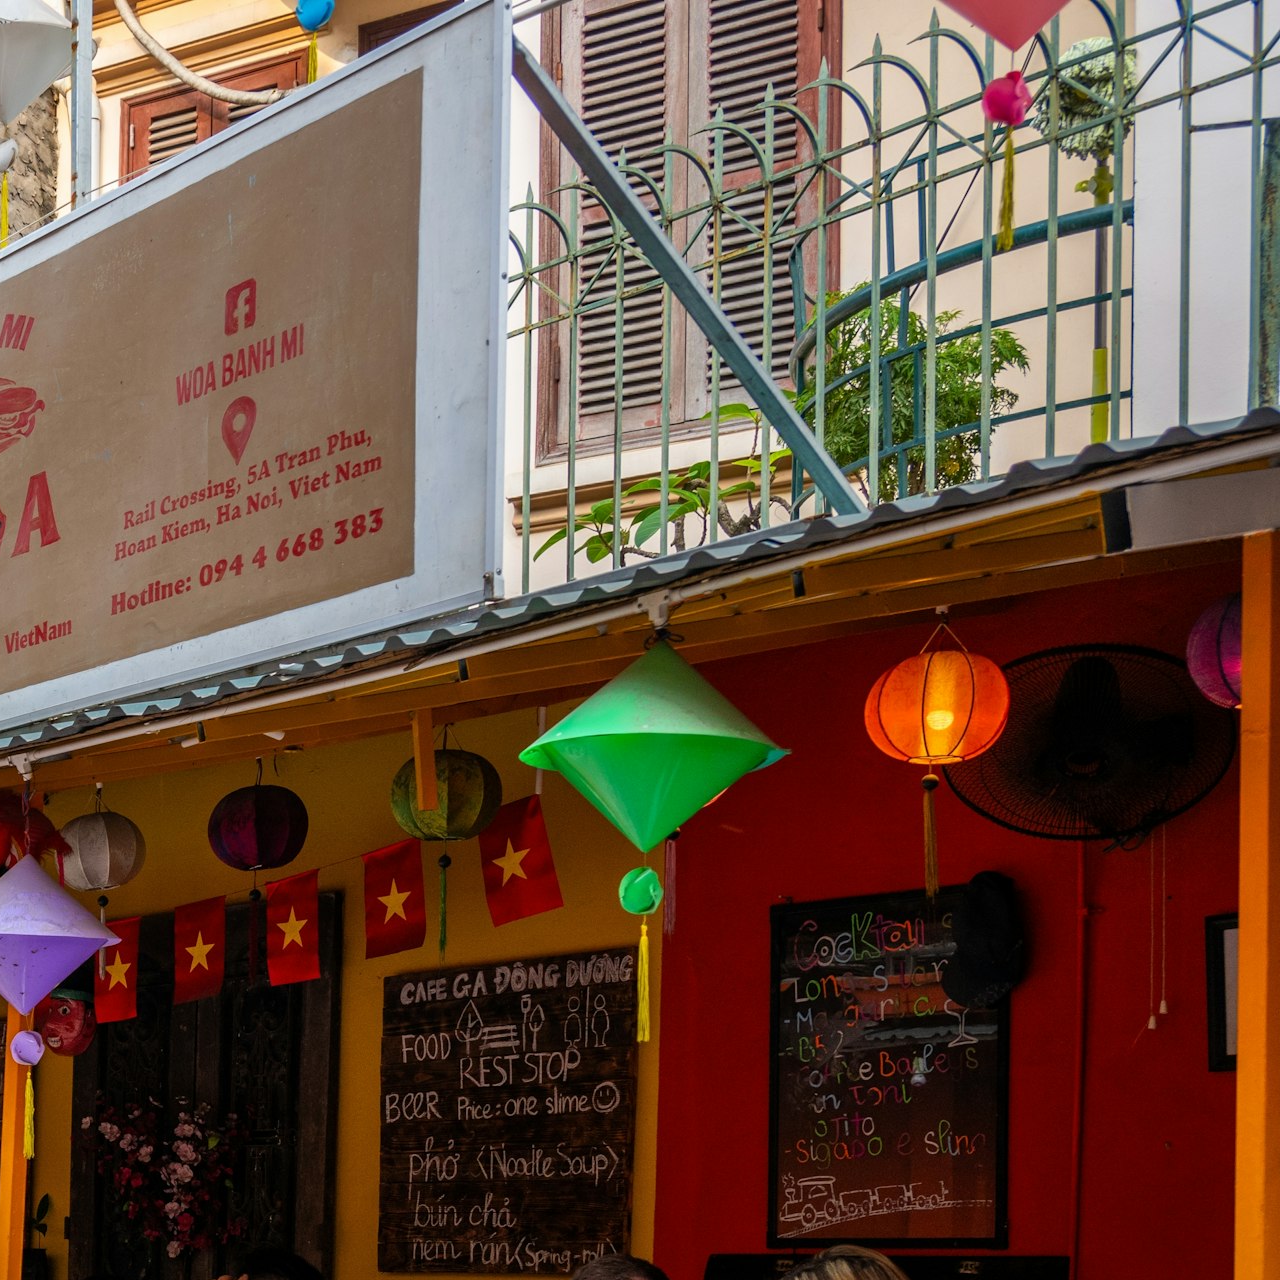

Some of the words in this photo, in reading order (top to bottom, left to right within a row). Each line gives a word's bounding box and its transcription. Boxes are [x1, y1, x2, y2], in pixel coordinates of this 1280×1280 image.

[175, 360, 217, 406] WOA
[221, 335, 275, 388] BANH
[280, 322, 305, 363] MI
[123, 500, 156, 530] Rail
[160, 476, 241, 515] Crossing,
[247, 460, 271, 485] 5A
[275, 446, 321, 474] Tran
[326, 429, 372, 457] Phu,
[114, 533, 157, 561] Hoan
[161, 516, 211, 545] Kiem,
[216, 504, 241, 526] Ha
[246, 487, 283, 515] Noi,
[288, 473, 330, 500] Viet
[335, 455, 382, 485] Nam
[110, 576, 192, 616] Hotline:
[199, 554, 244, 587] 094
[251, 546, 268, 570] 4
[275, 528, 324, 562] 668
[334, 507, 384, 545] 383
[4, 619, 72, 654] VietNam
[400, 977, 448, 1005] CAFE
[452, 970, 488, 999] GA
[401, 1033, 451, 1063] FOOD
[459, 1053, 520, 1089] REST
[521, 1048, 581, 1085] STOP
[504, 1096, 538, 1117] one
[545, 1086, 592, 1115] slime
[411, 1237, 463, 1262] nem
